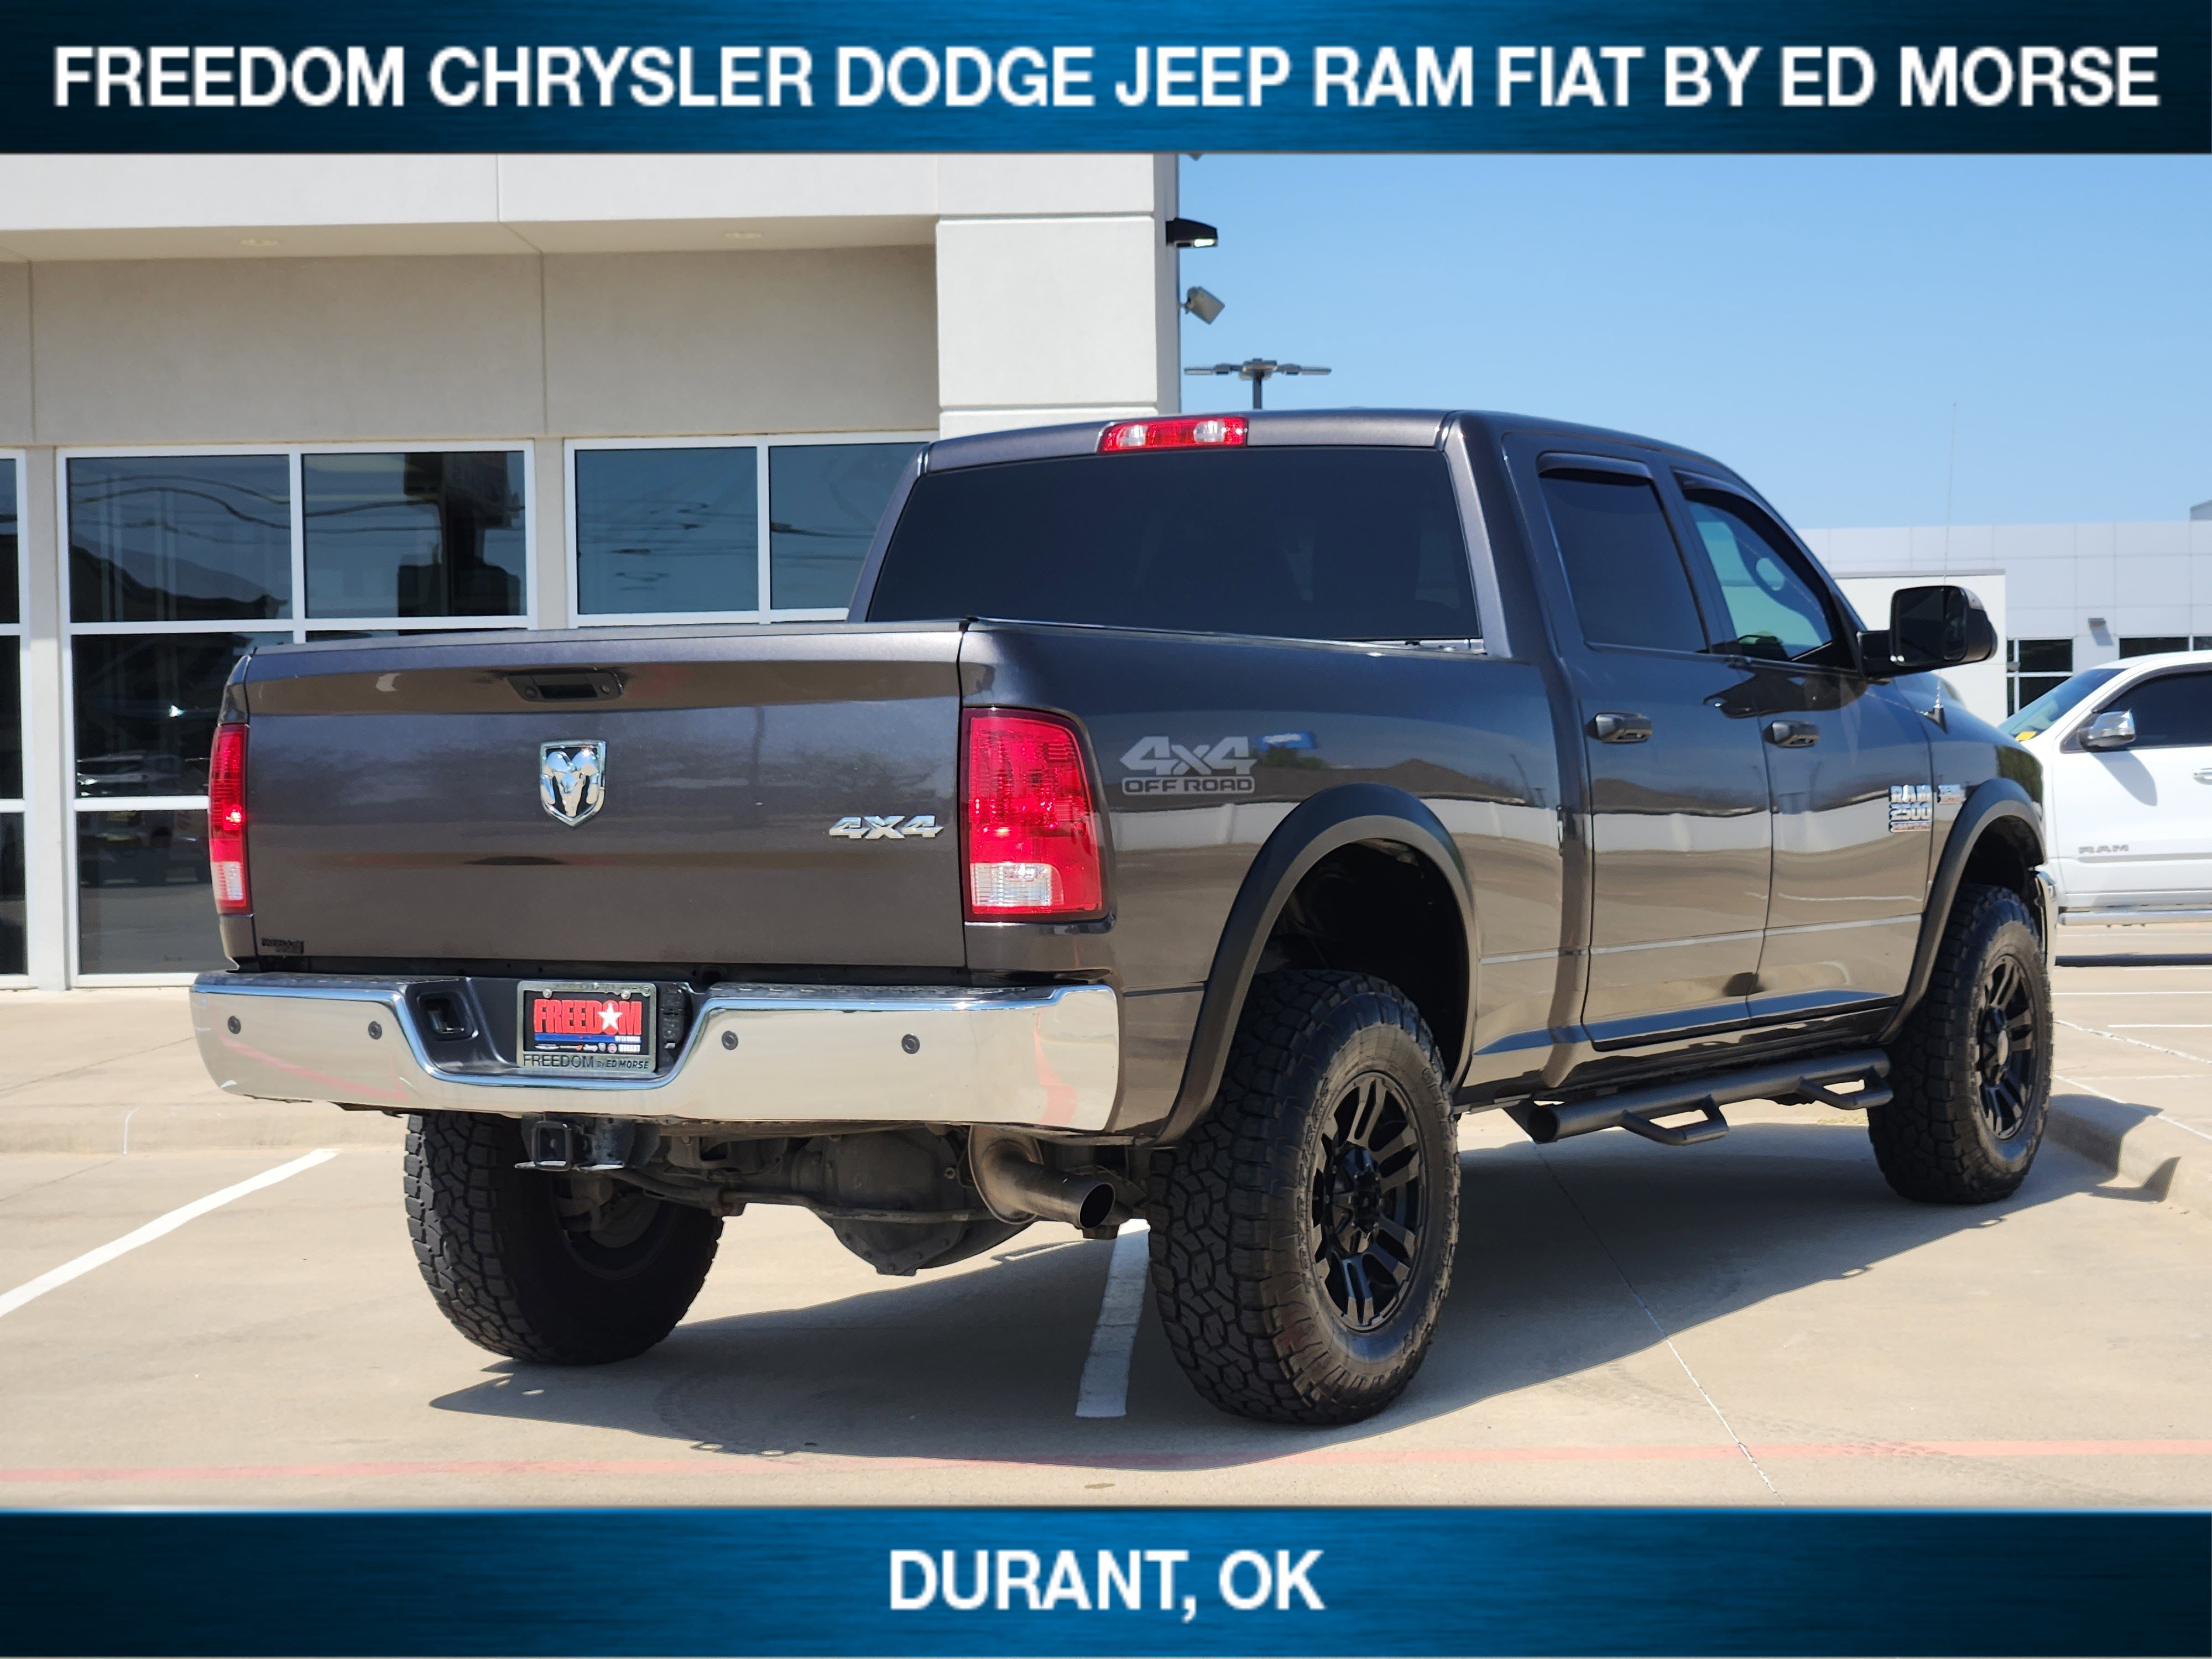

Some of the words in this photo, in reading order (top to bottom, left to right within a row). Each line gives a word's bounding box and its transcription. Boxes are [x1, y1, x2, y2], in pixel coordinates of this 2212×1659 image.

[1125, 779, 1177, 792] OFF
[1184, 779, 1252, 792] ROAD
[829, 815, 945, 839] 4X4
[2078, 844, 2129, 854] RAM
[523, 1054, 594, 1068] FREEDOM
